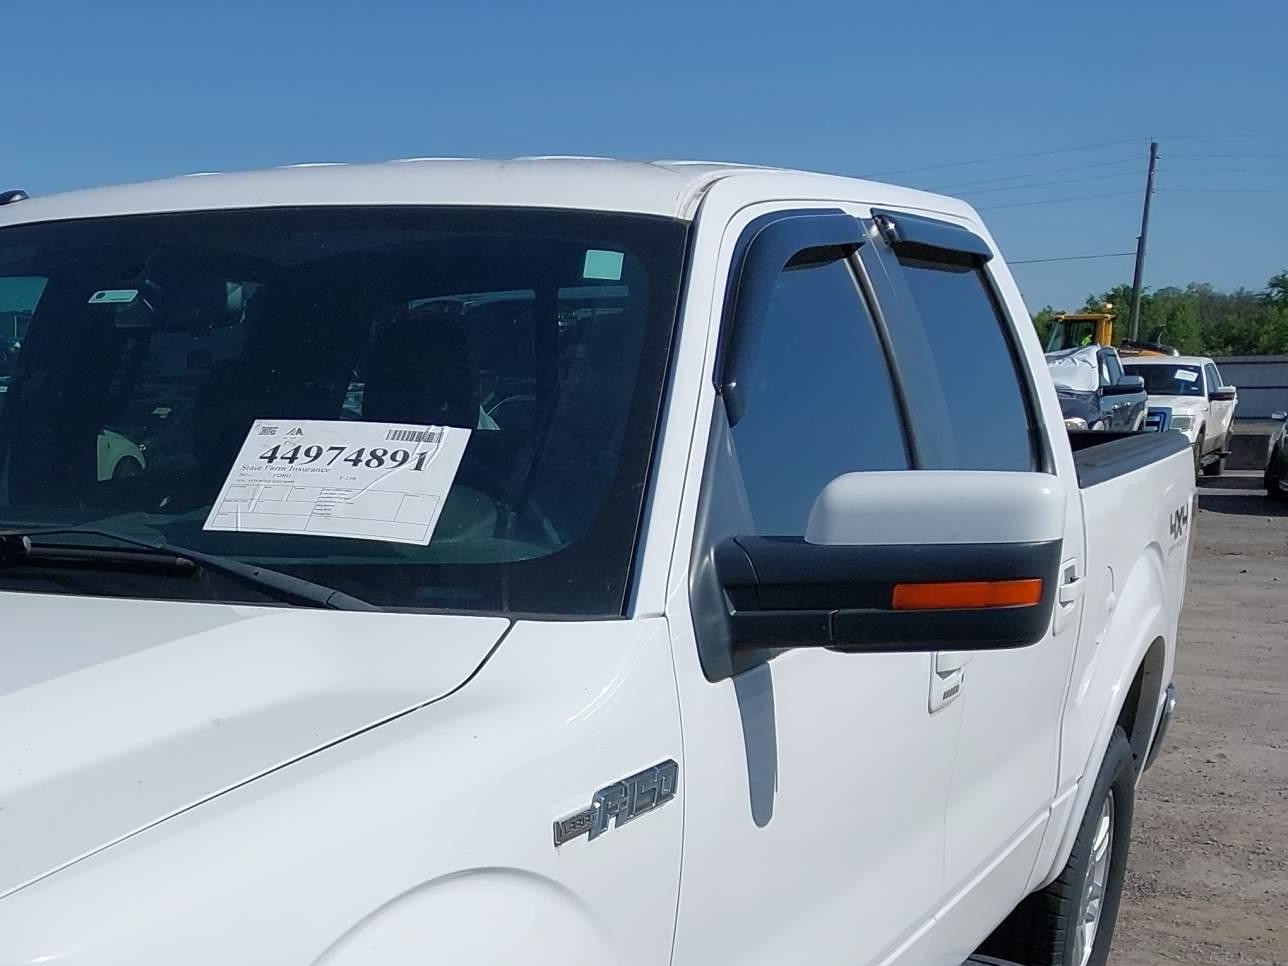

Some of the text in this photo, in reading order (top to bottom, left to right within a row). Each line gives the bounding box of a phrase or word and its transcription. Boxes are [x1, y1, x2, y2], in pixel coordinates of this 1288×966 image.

[259, 444, 429, 472] 44974891
[264, 464, 286, 472] Farm
[288, 465, 331, 473] Insurance
